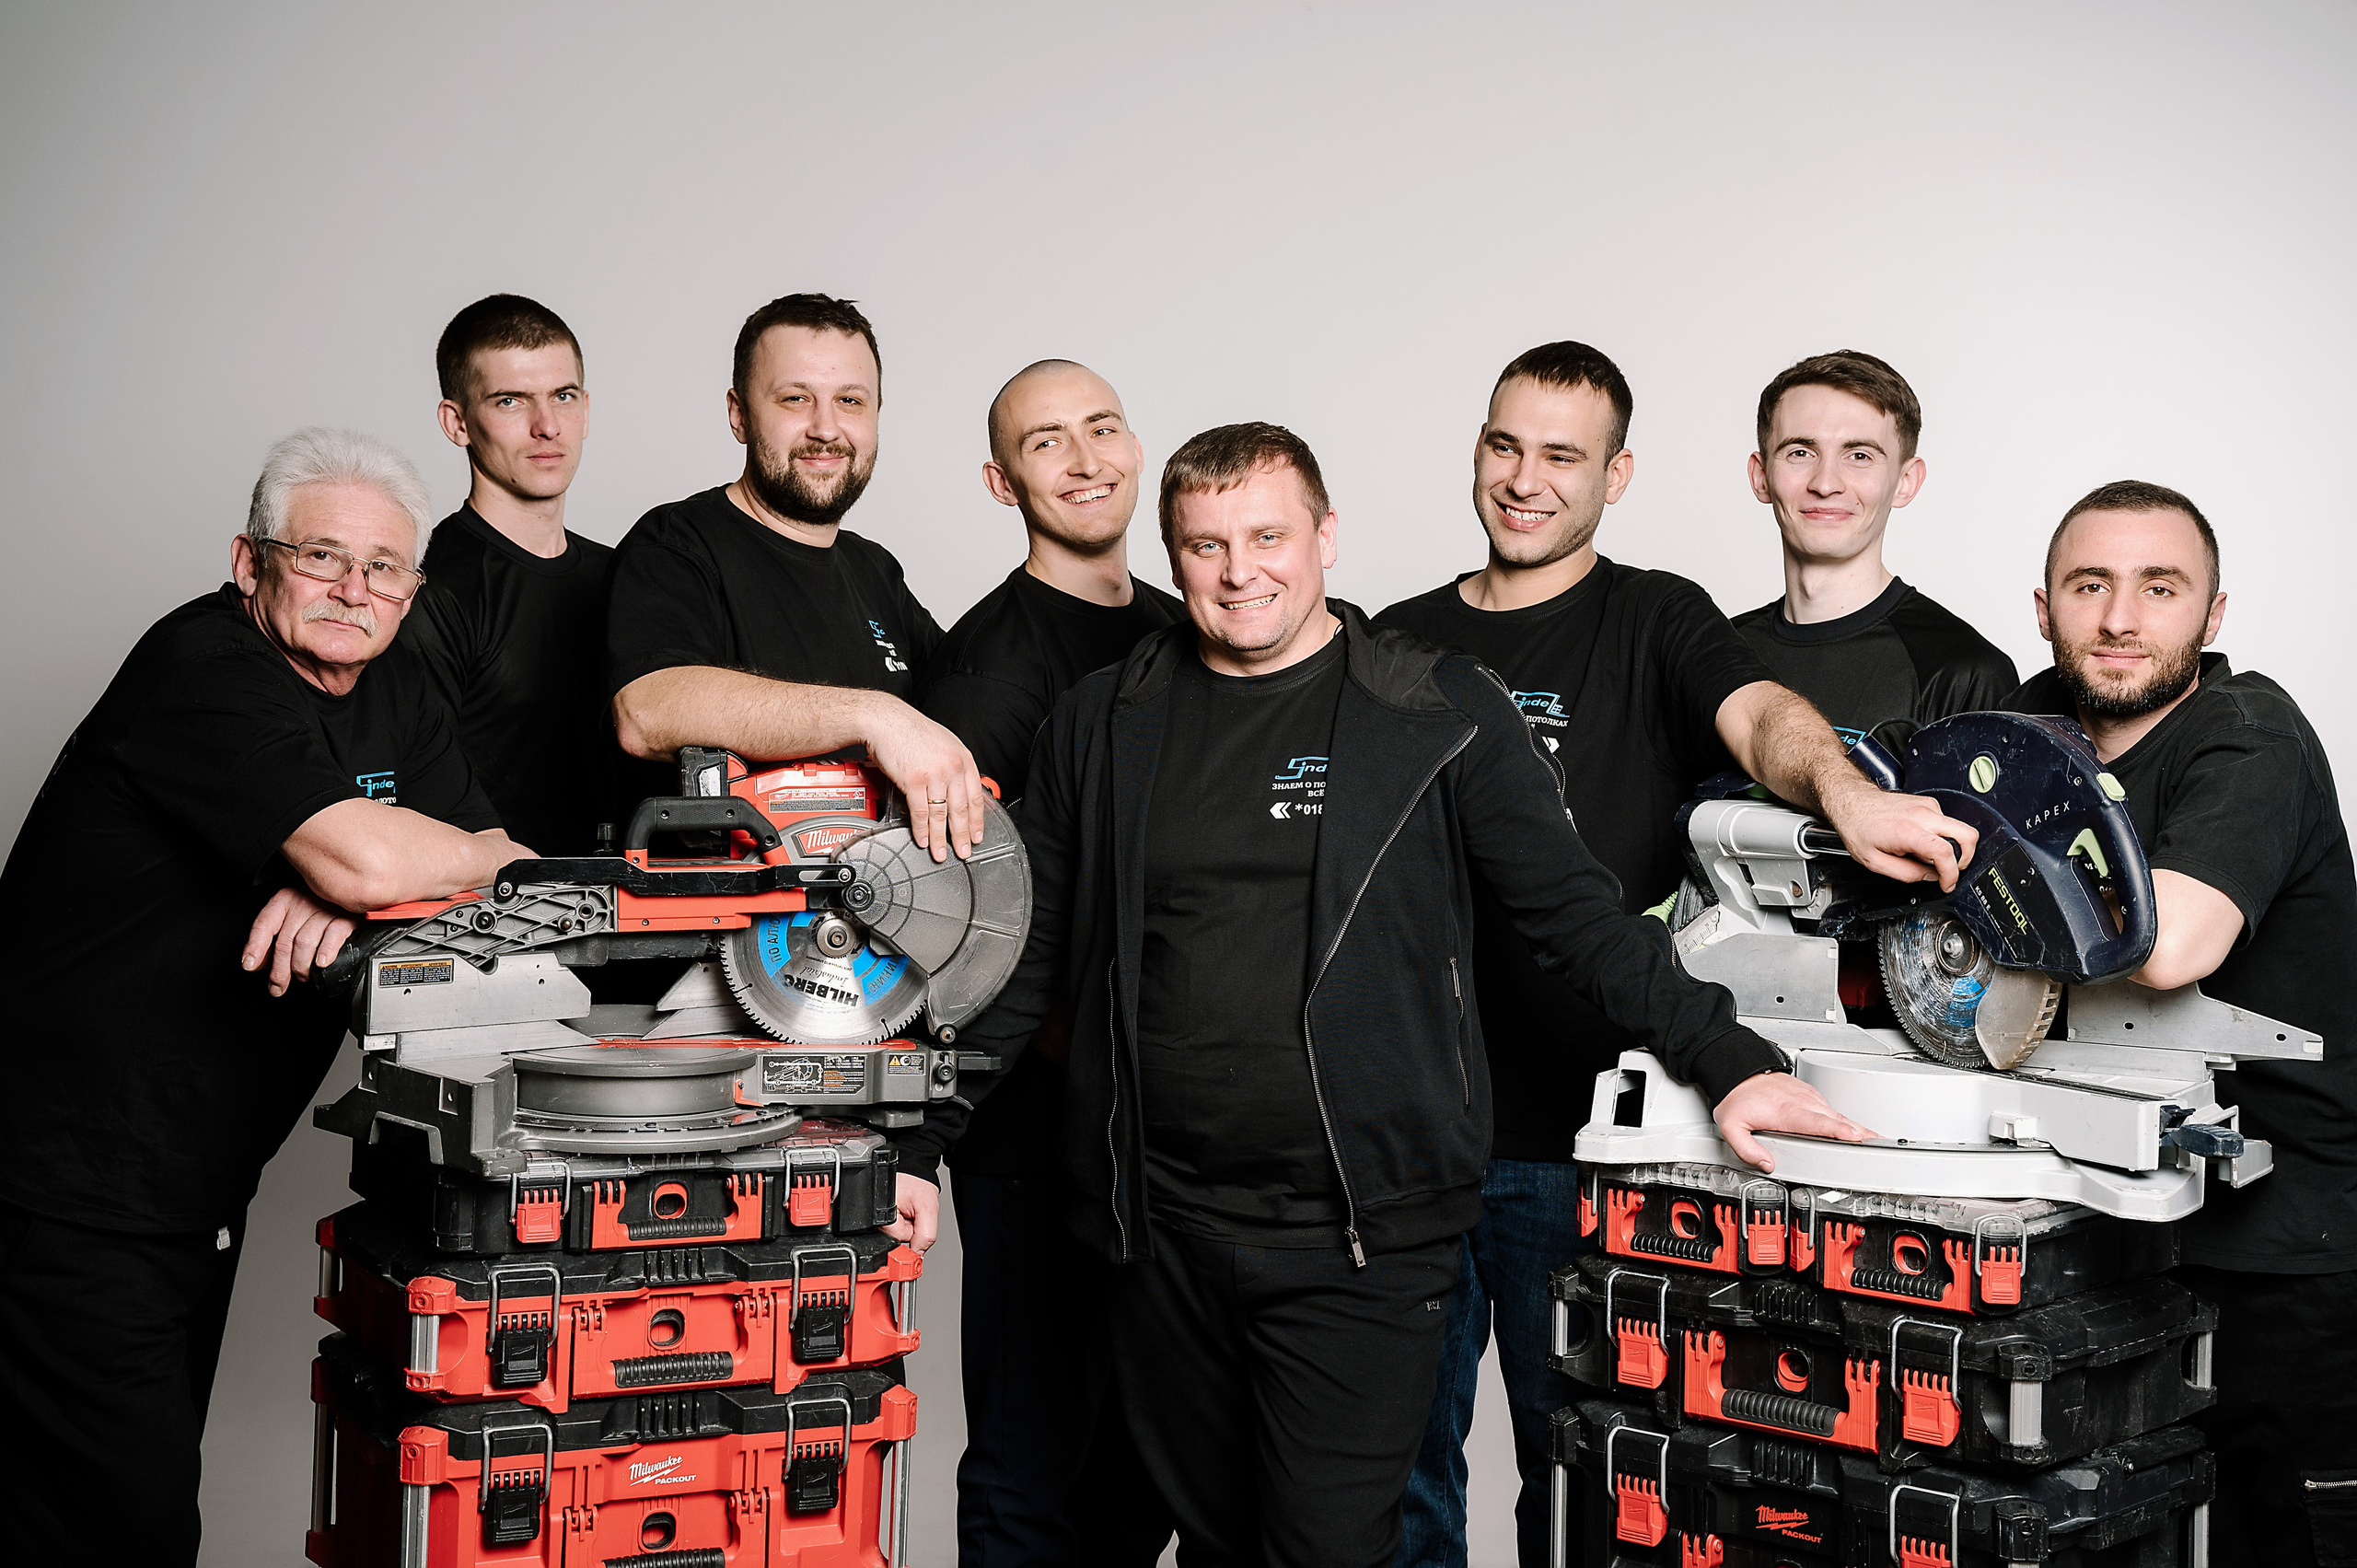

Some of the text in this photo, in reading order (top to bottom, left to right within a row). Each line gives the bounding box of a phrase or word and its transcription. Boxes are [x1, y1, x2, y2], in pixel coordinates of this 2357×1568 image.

[1271, 782, 1304, 790] ЗНАЕМ
[2026, 800, 2071, 830] KAPEX
[805, 830, 858, 849] Milwau
[1989, 867, 2027, 935] FESTOOL
[629, 1456, 682, 1481] Milwaukee
[655, 1475, 697, 1484] PACKOUT
[1755, 1504, 1809, 1523] Milwaukee
[1782, 1528, 1822, 1543] PACKOUT
